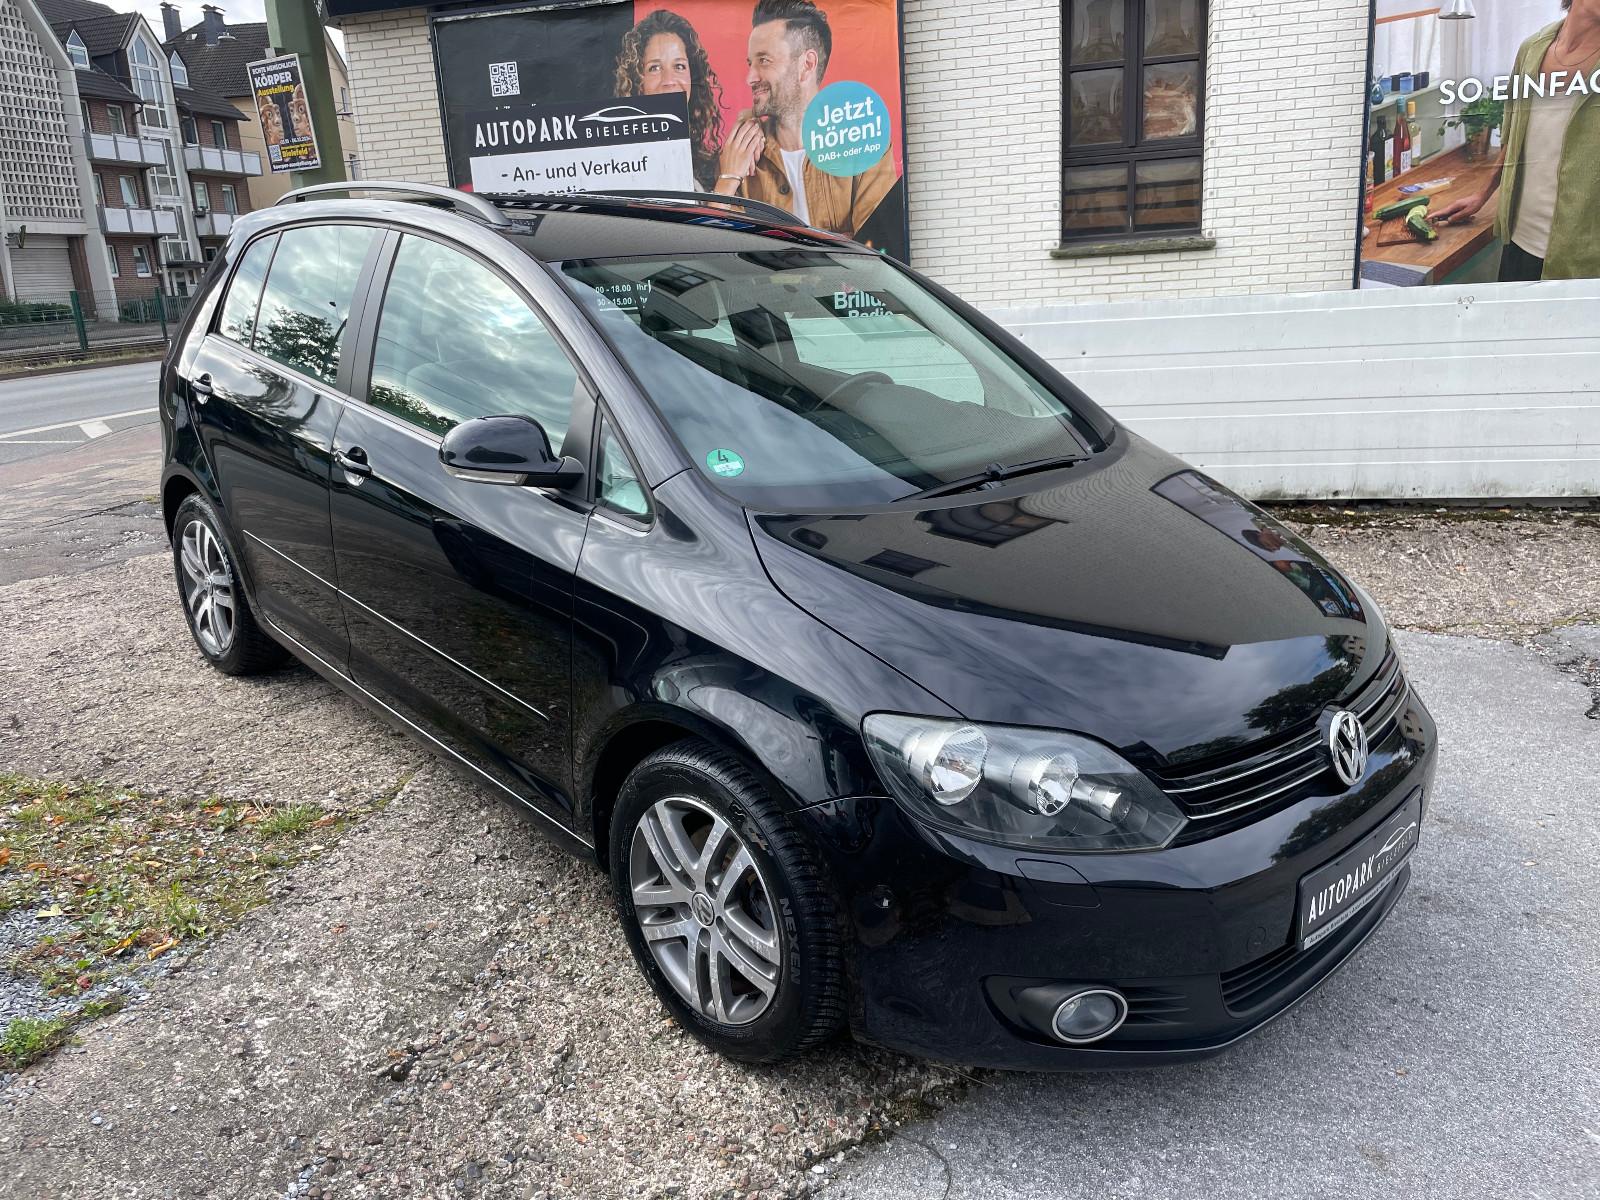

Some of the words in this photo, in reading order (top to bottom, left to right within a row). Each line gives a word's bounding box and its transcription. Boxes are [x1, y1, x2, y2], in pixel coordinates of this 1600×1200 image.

[254, 71, 293, 88] KÖRPER
[257, 84, 294, 97] Ausstellung
[1439, 77, 1483, 105] SO
[817, 96, 874, 127] Jetzt
[475, 114, 578, 148] AUTOPARK
[585, 121, 670, 139] BIELEFELD
[810, 115, 882, 151] hören!
[282, 147, 309, 158] Bielefeld
[818, 151, 842, 163] DAB+
[843, 147, 862, 157] oder
[864, 143, 881, 153] App
[513, 166, 541, 182] An-
[546, 162, 576, 179] und
[582, 156, 648, 176] Verkauf
[611, 284, 631, 293] 18.00
[834, 290, 886, 310] Brillu
[717, 449, 729, 462] 4
[1308, 854, 1375, 924] AUTOPARK
[780, 898, 801, 985] NEXEN
